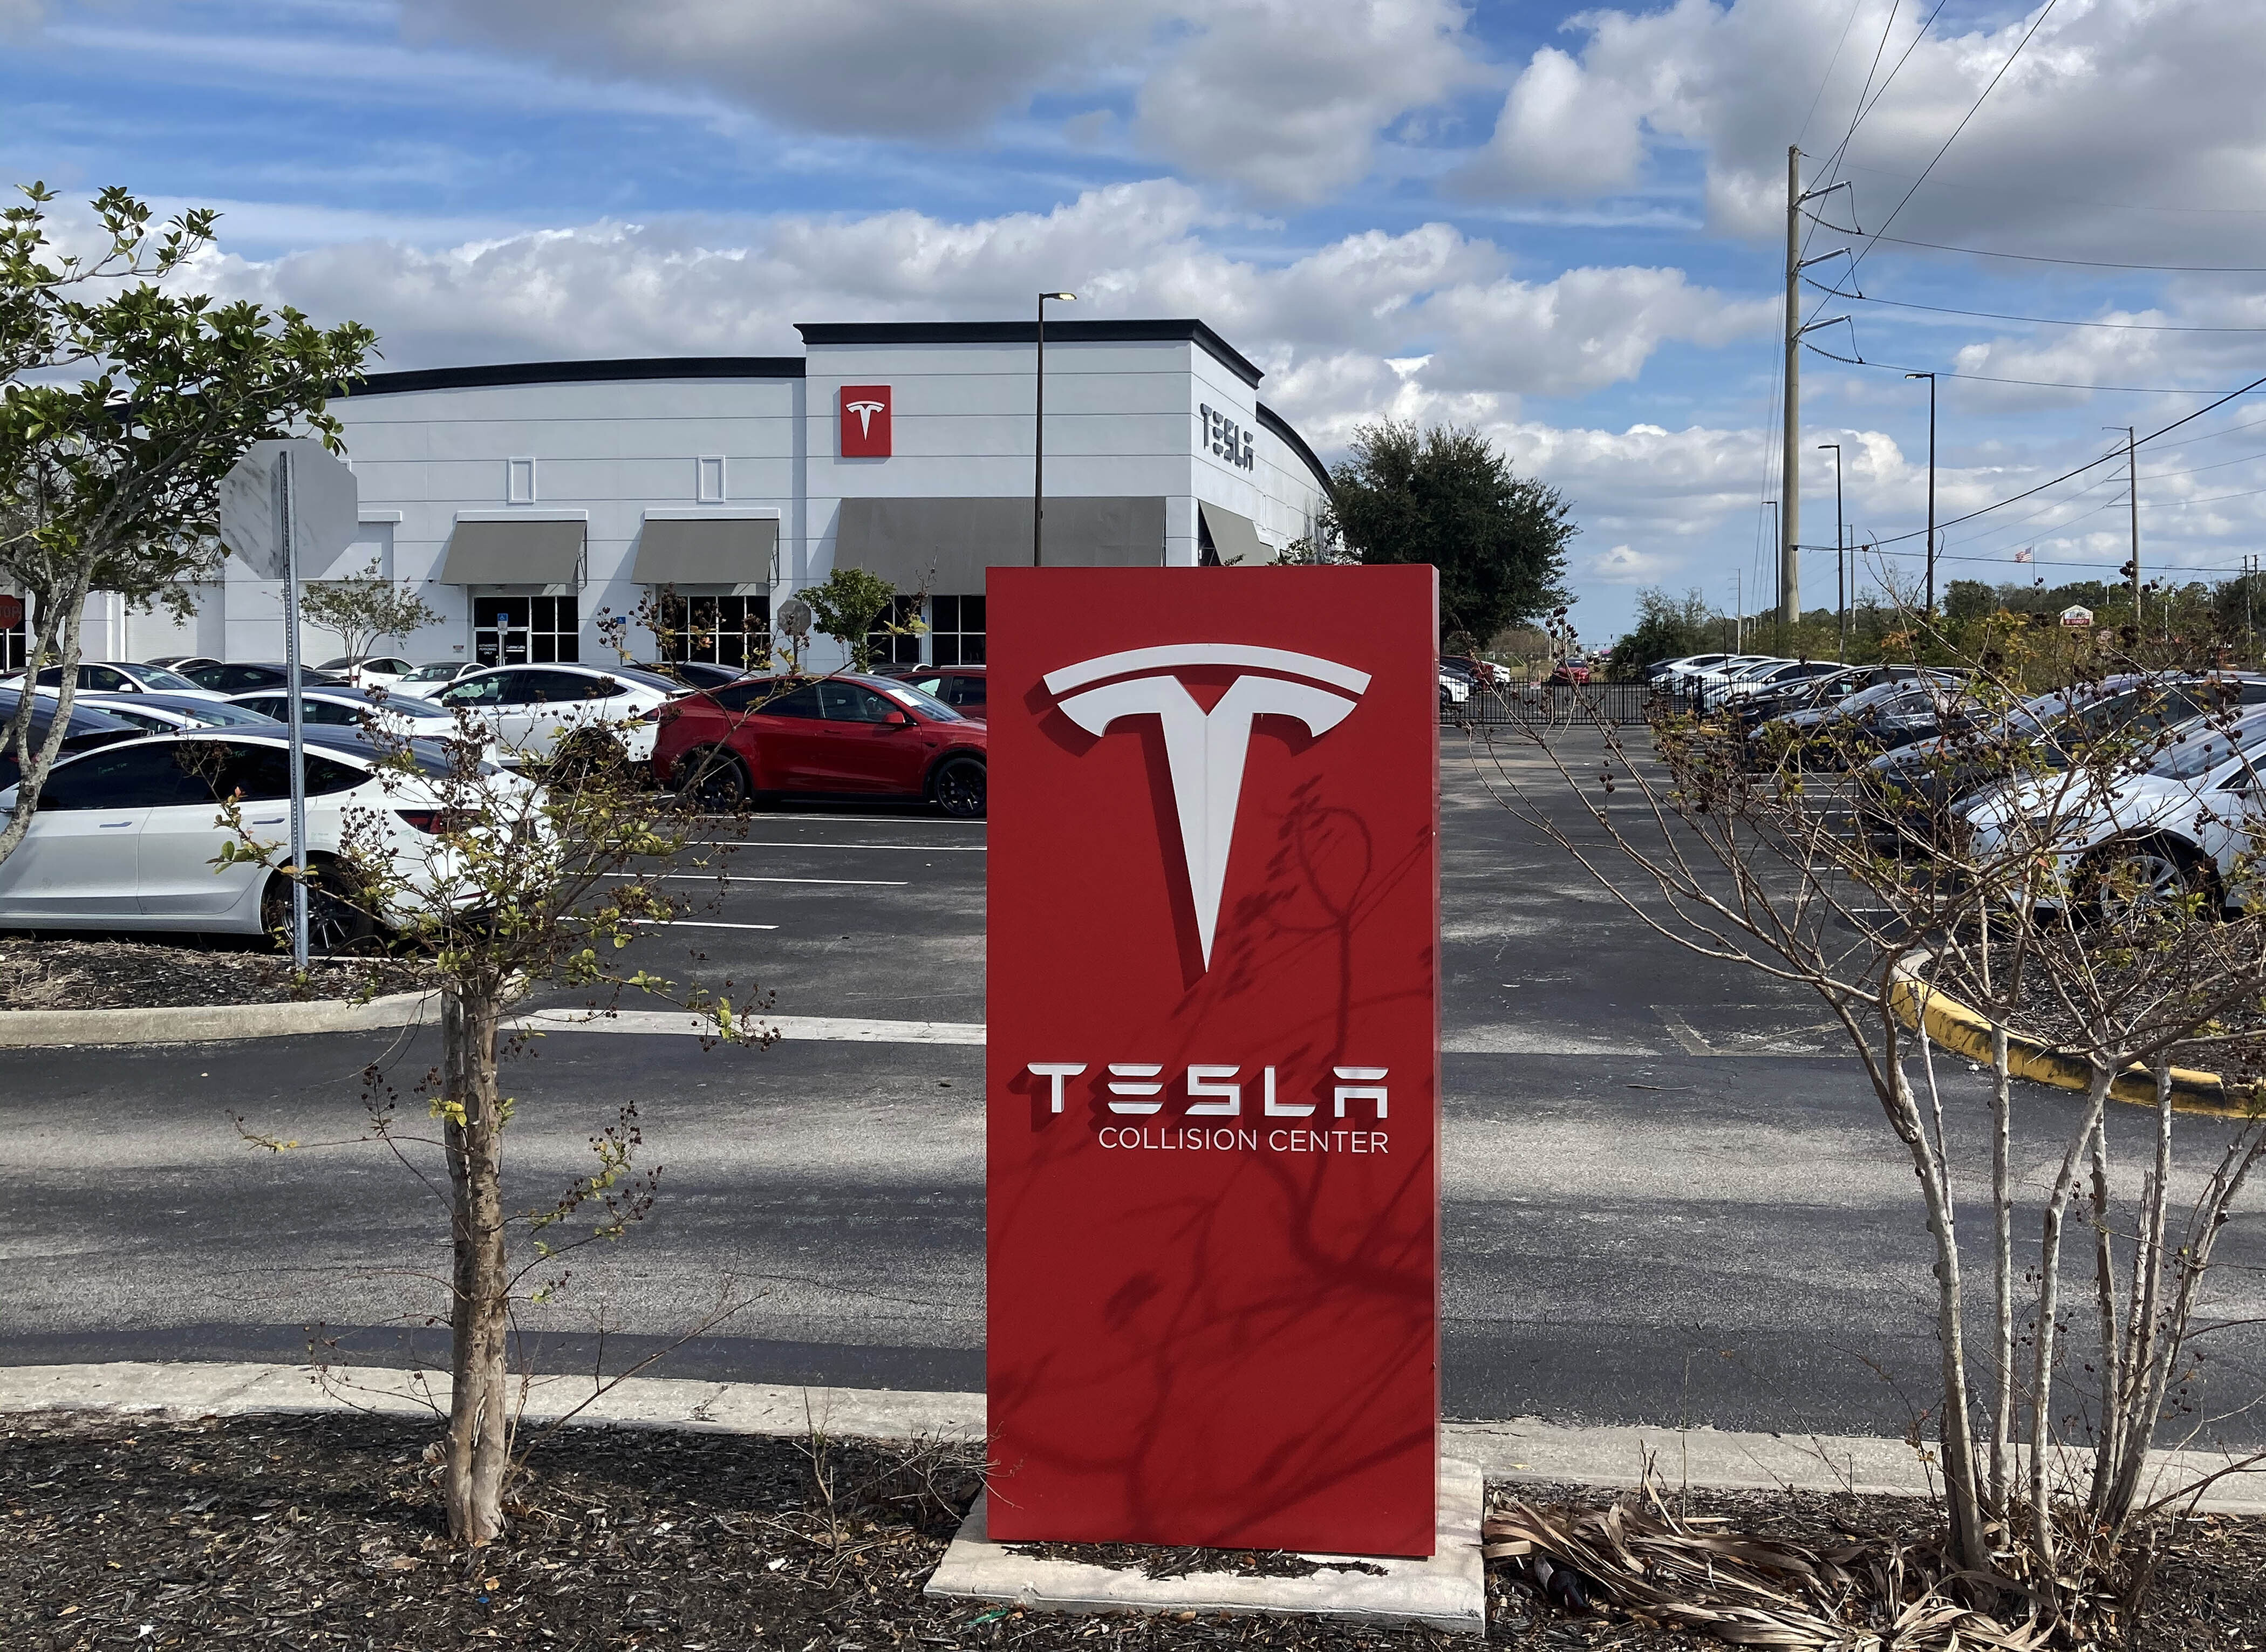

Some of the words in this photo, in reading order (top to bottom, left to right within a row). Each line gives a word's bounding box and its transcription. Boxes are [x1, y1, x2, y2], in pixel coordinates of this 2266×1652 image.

[1200, 403, 1253, 473] TESLA
[0, 605, 18, 618] TOP
[1027, 1062, 1389, 1118] TESLA
[1098, 1127, 1257, 1151] COLLISION
[1269, 1130, 1389, 1153] CENTER
